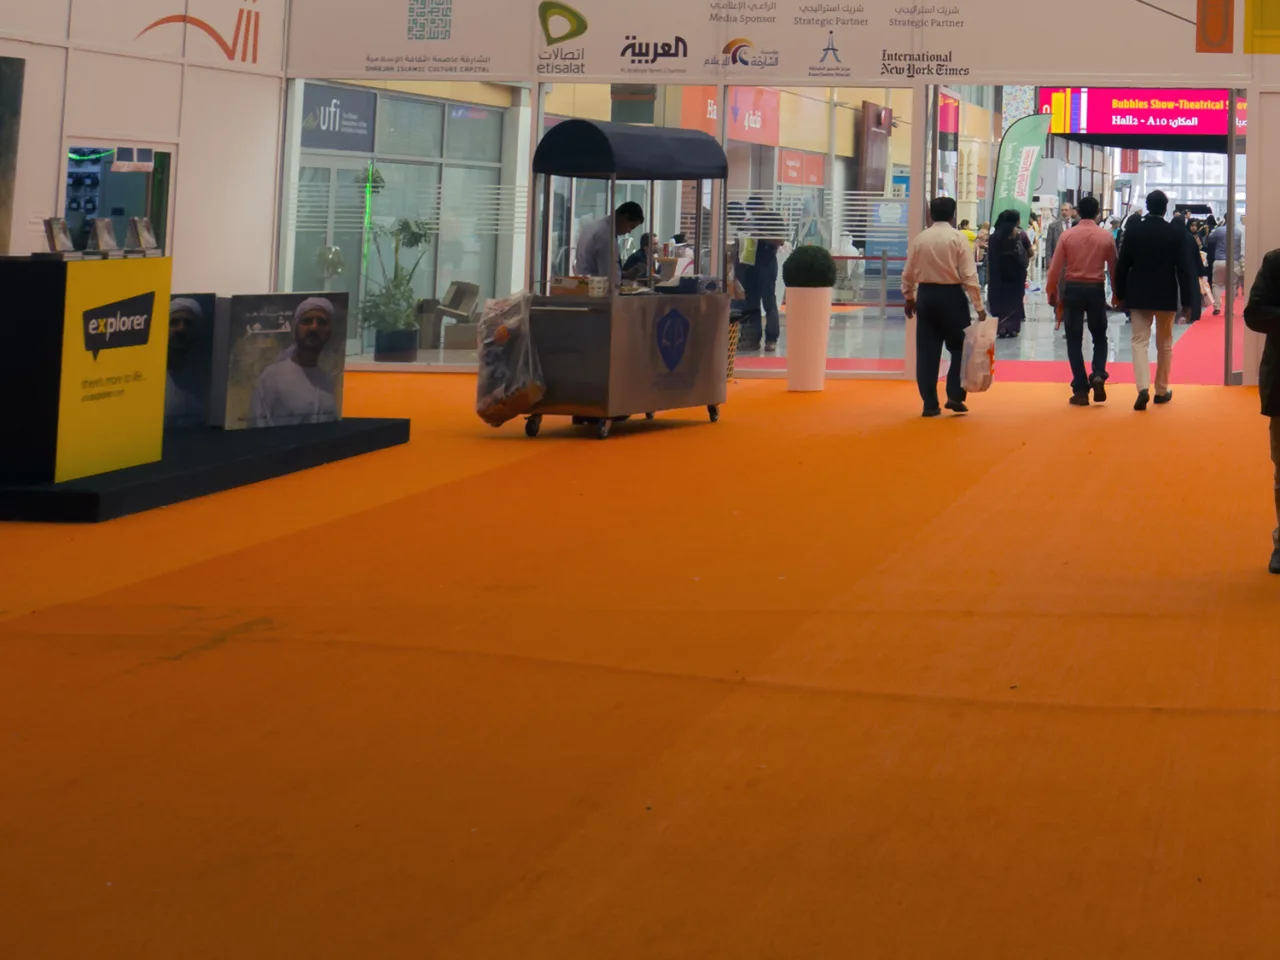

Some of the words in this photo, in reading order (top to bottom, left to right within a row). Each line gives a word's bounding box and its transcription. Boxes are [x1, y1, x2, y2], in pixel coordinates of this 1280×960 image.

[748, 2, 777, 11] الراعي
[842, 4, 864, 14] شريك
[936, 6, 960, 15] شريك
[709, 13, 738, 23] Media
[740, 14, 776, 25] Sponsor
[793, 16, 833, 27] Strategic
[835, 17, 869, 26] Partner
[889, 18, 928, 28] Strategic
[930, 18, 964, 27] Partner
[538, 47, 585, 60] اتصالات
[620, 35, 688, 64] العربية
[881, 49, 953, 63] International
[536, 62, 585, 74] etisalat
[880, 63, 904, 76] New
[906, 63, 934, 78] York
[936, 63, 970, 76] Times
[1112, 99, 1148, 109] Bubbles
[1150, 99, 1224, 110] Show-Theatrical
[320, 99, 340, 132] ufi
[1112, 115, 1138, 125] Hall2
[1147, 116, 1167, 126] A10
[88, 310, 148, 342] explorer
